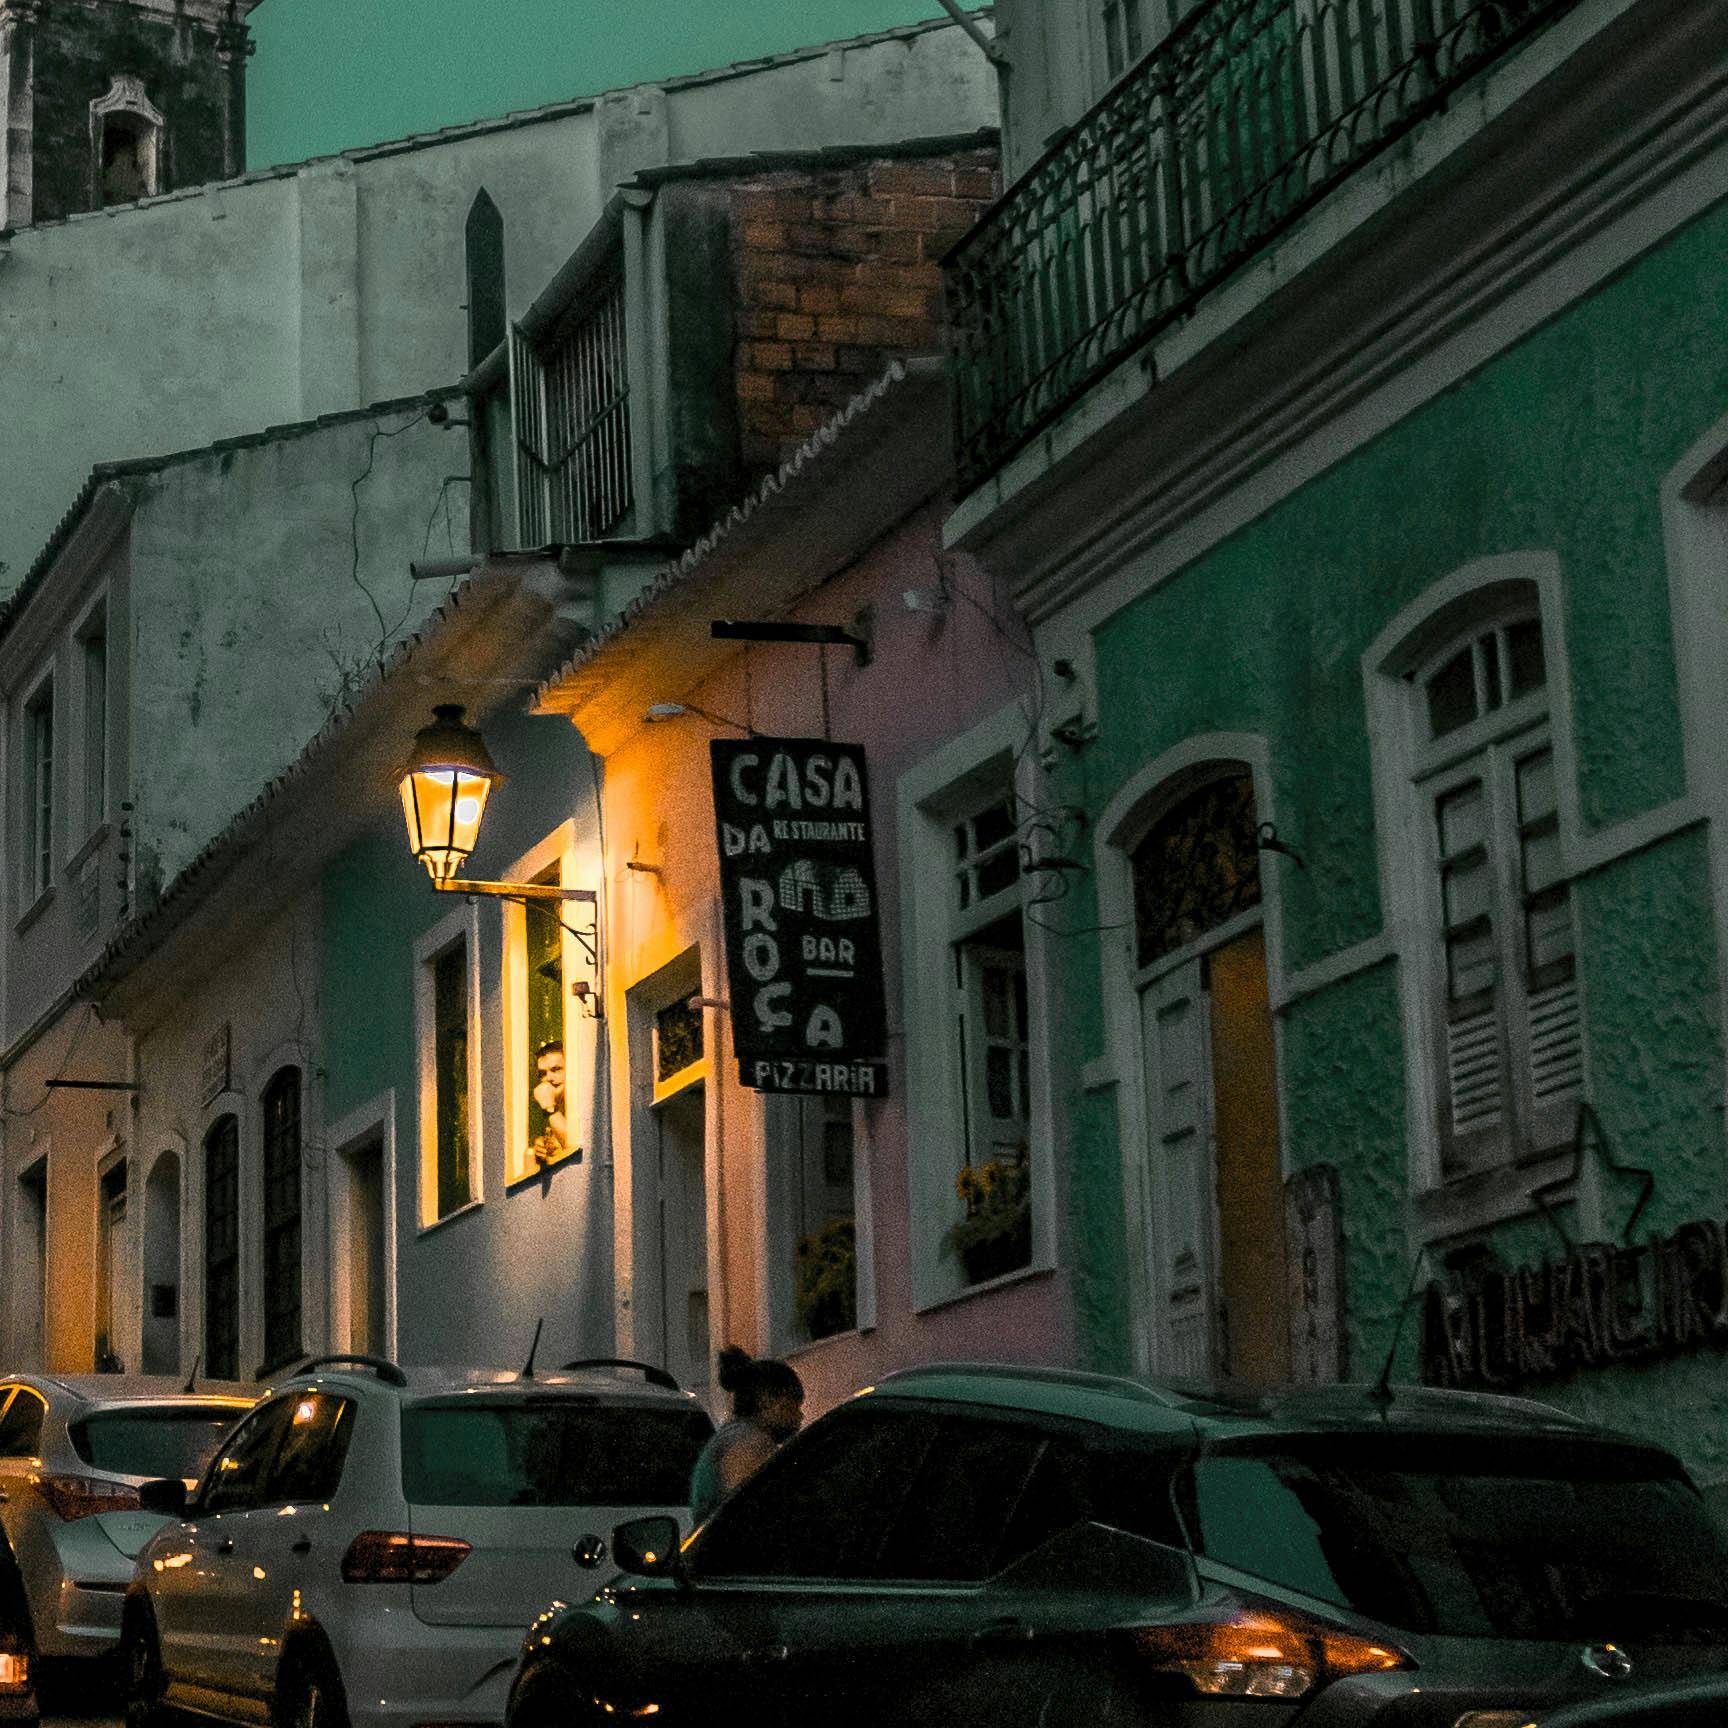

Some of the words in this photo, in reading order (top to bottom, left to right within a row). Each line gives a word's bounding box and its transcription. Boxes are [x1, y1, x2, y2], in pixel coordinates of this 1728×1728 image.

[730, 753, 863, 810] CASA
[722, 822, 770, 857] DA
[773, 820, 866, 841] RESTAURANTE
[801, 934, 856, 967] BAR
